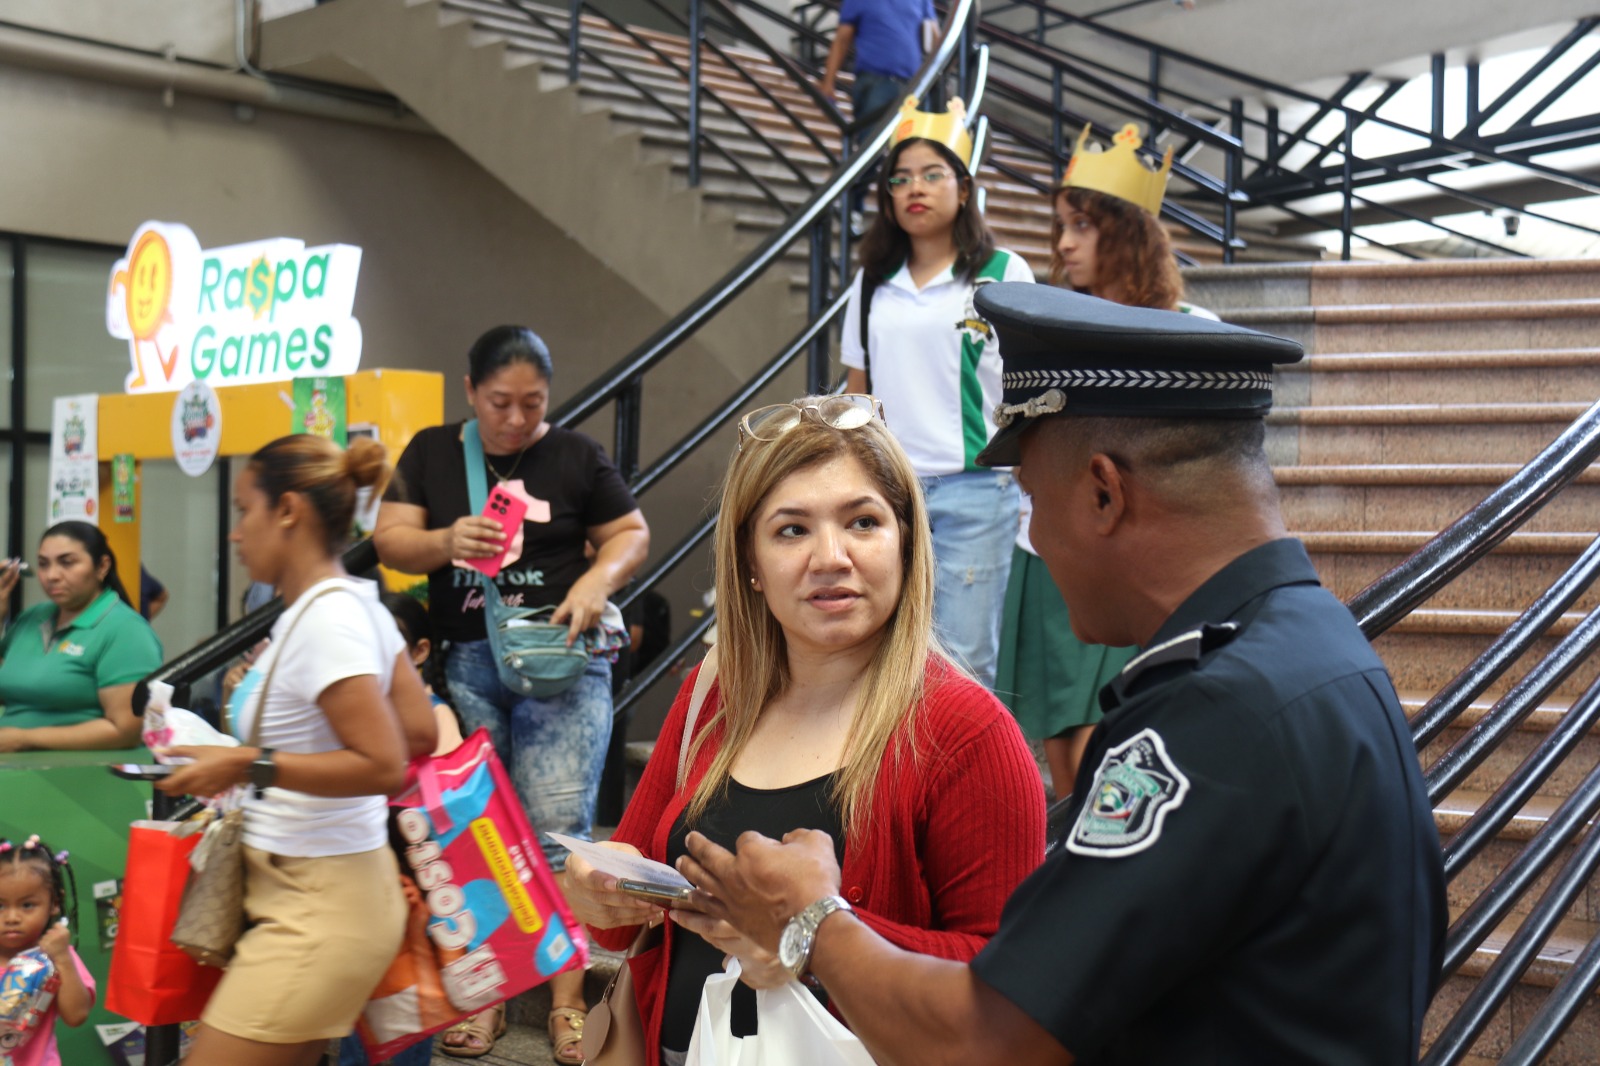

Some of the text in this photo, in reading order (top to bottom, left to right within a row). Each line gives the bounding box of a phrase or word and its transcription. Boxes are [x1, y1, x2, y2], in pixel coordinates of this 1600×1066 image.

[191, 324, 332, 379] Games
[396, 808, 508, 1001] El Costo
